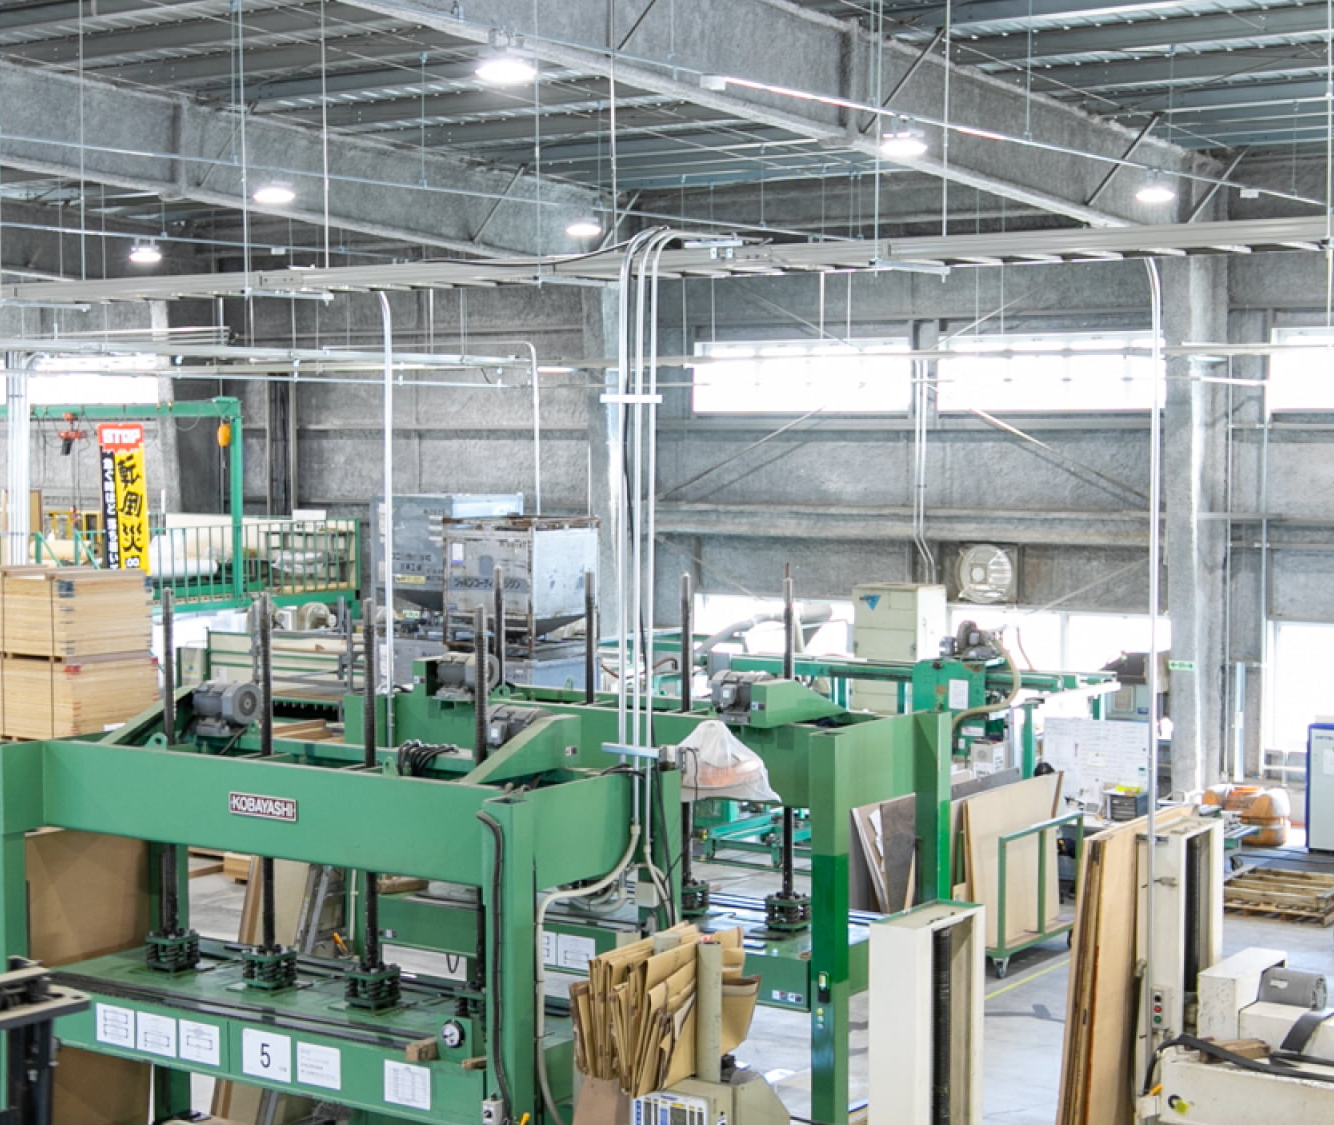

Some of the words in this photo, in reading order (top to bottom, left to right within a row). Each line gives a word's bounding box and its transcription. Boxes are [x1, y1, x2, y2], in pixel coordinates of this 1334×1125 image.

[102, 429, 140, 443] STOP
[231, 794, 294, 817] KOBAYASHI
[259, 1043, 272, 1069] 5
